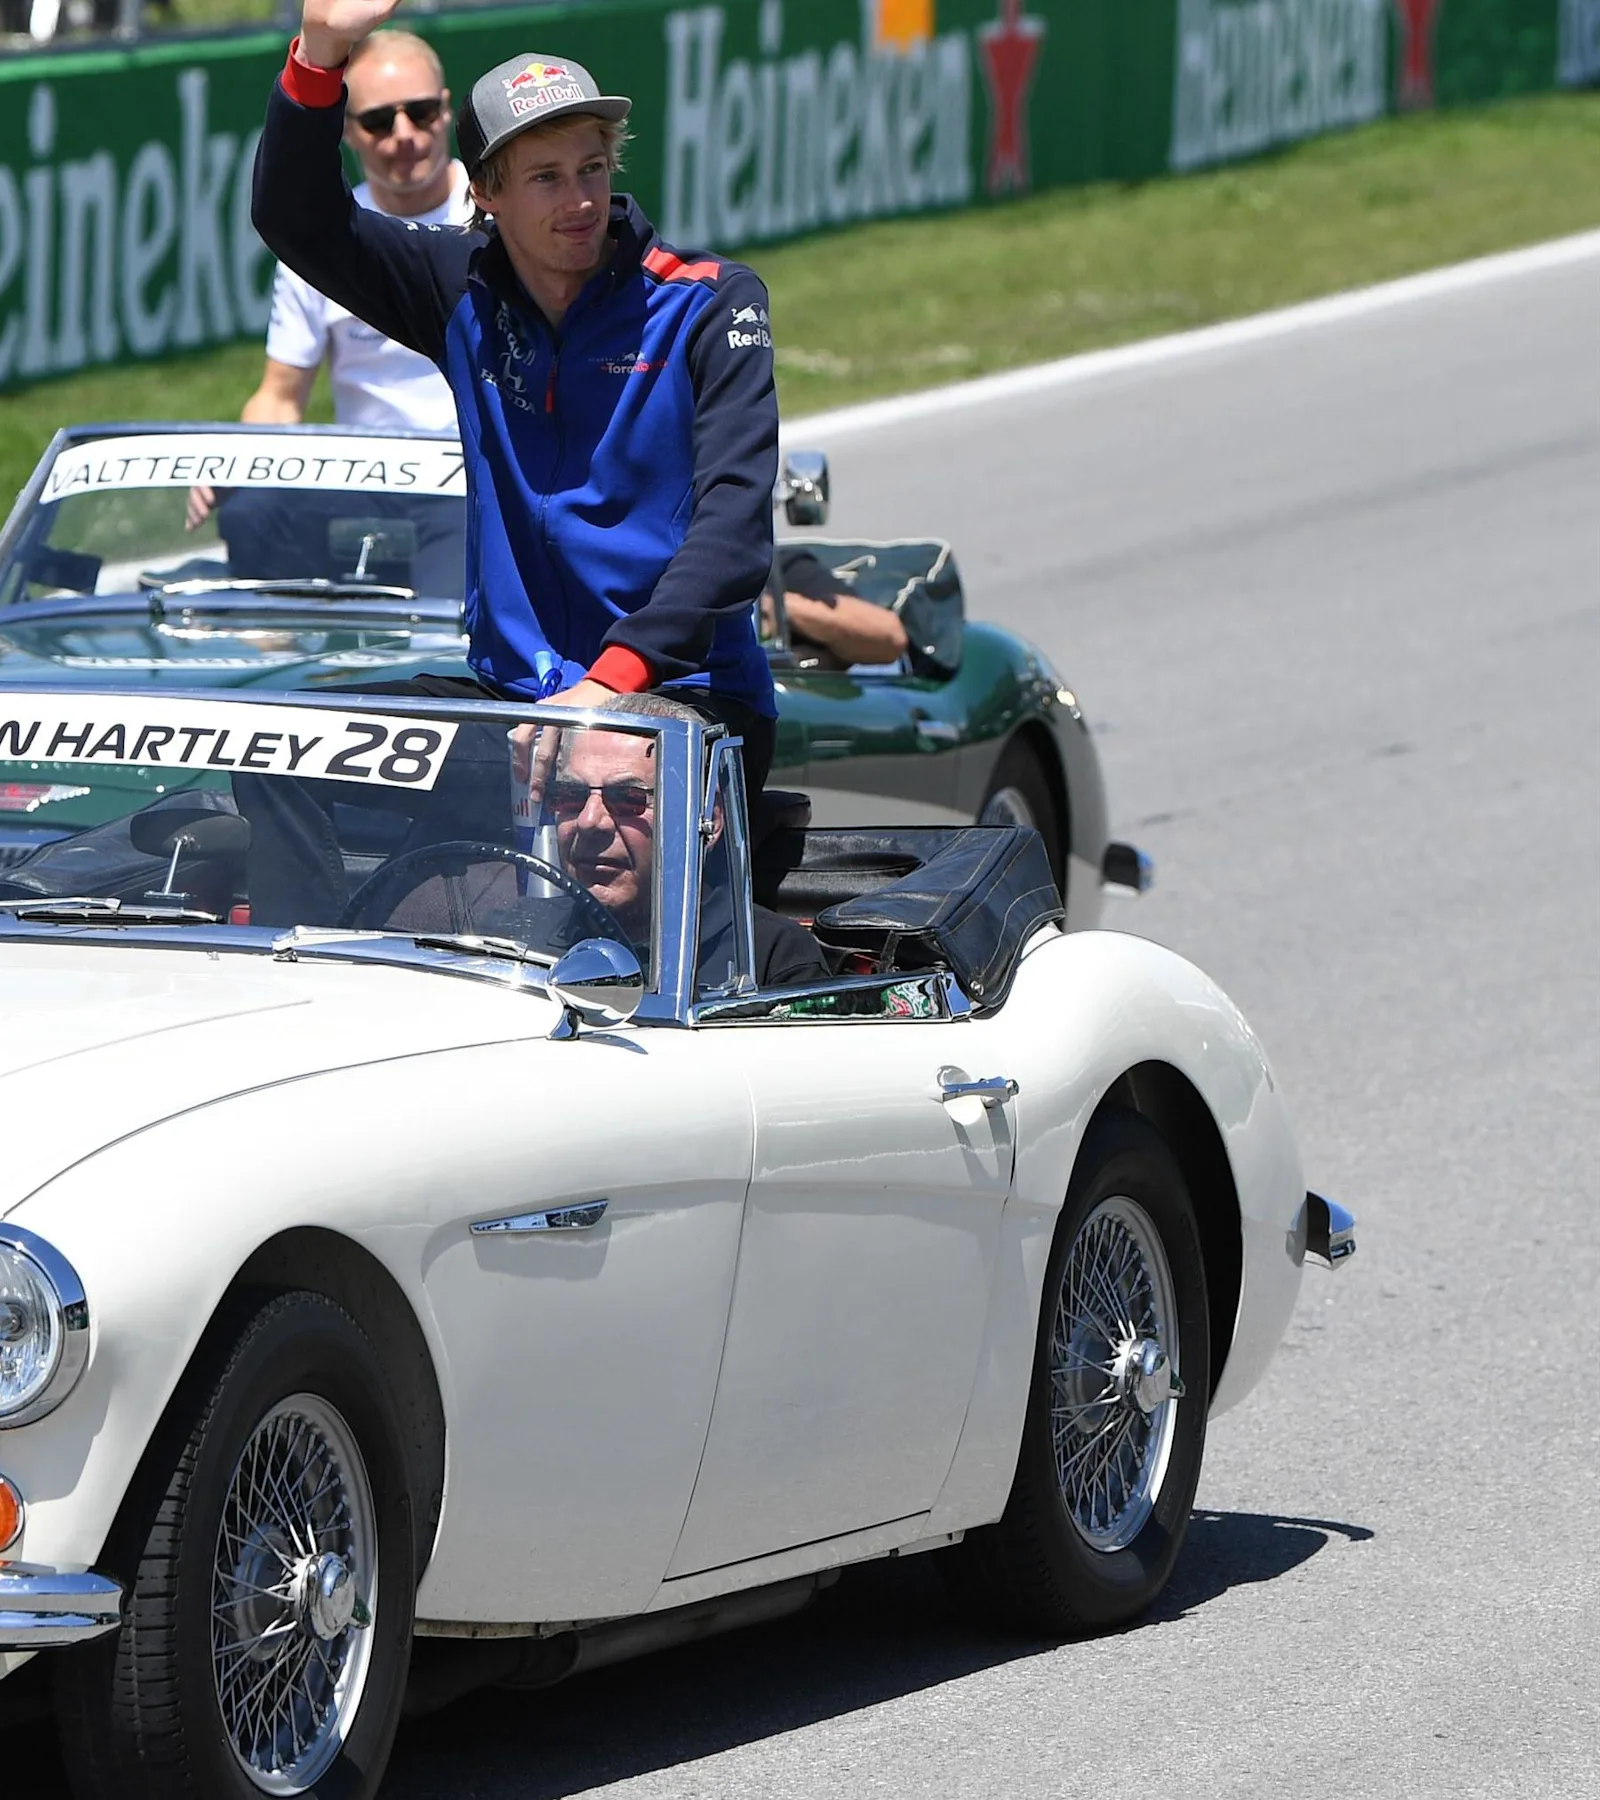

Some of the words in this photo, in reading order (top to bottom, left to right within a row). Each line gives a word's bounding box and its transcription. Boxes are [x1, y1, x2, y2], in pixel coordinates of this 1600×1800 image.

[511, 88, 549, 116] Red
[550, 84, 584, 102] Bull
[662, 0, 972, 250] Heineken
[51, 455, 236, 494] VALTTERI
[247, 455, 421, 486] BOTTAS
[45, 721, 324, 771] HARTLEY
[324, 721, 443, 783] 28
